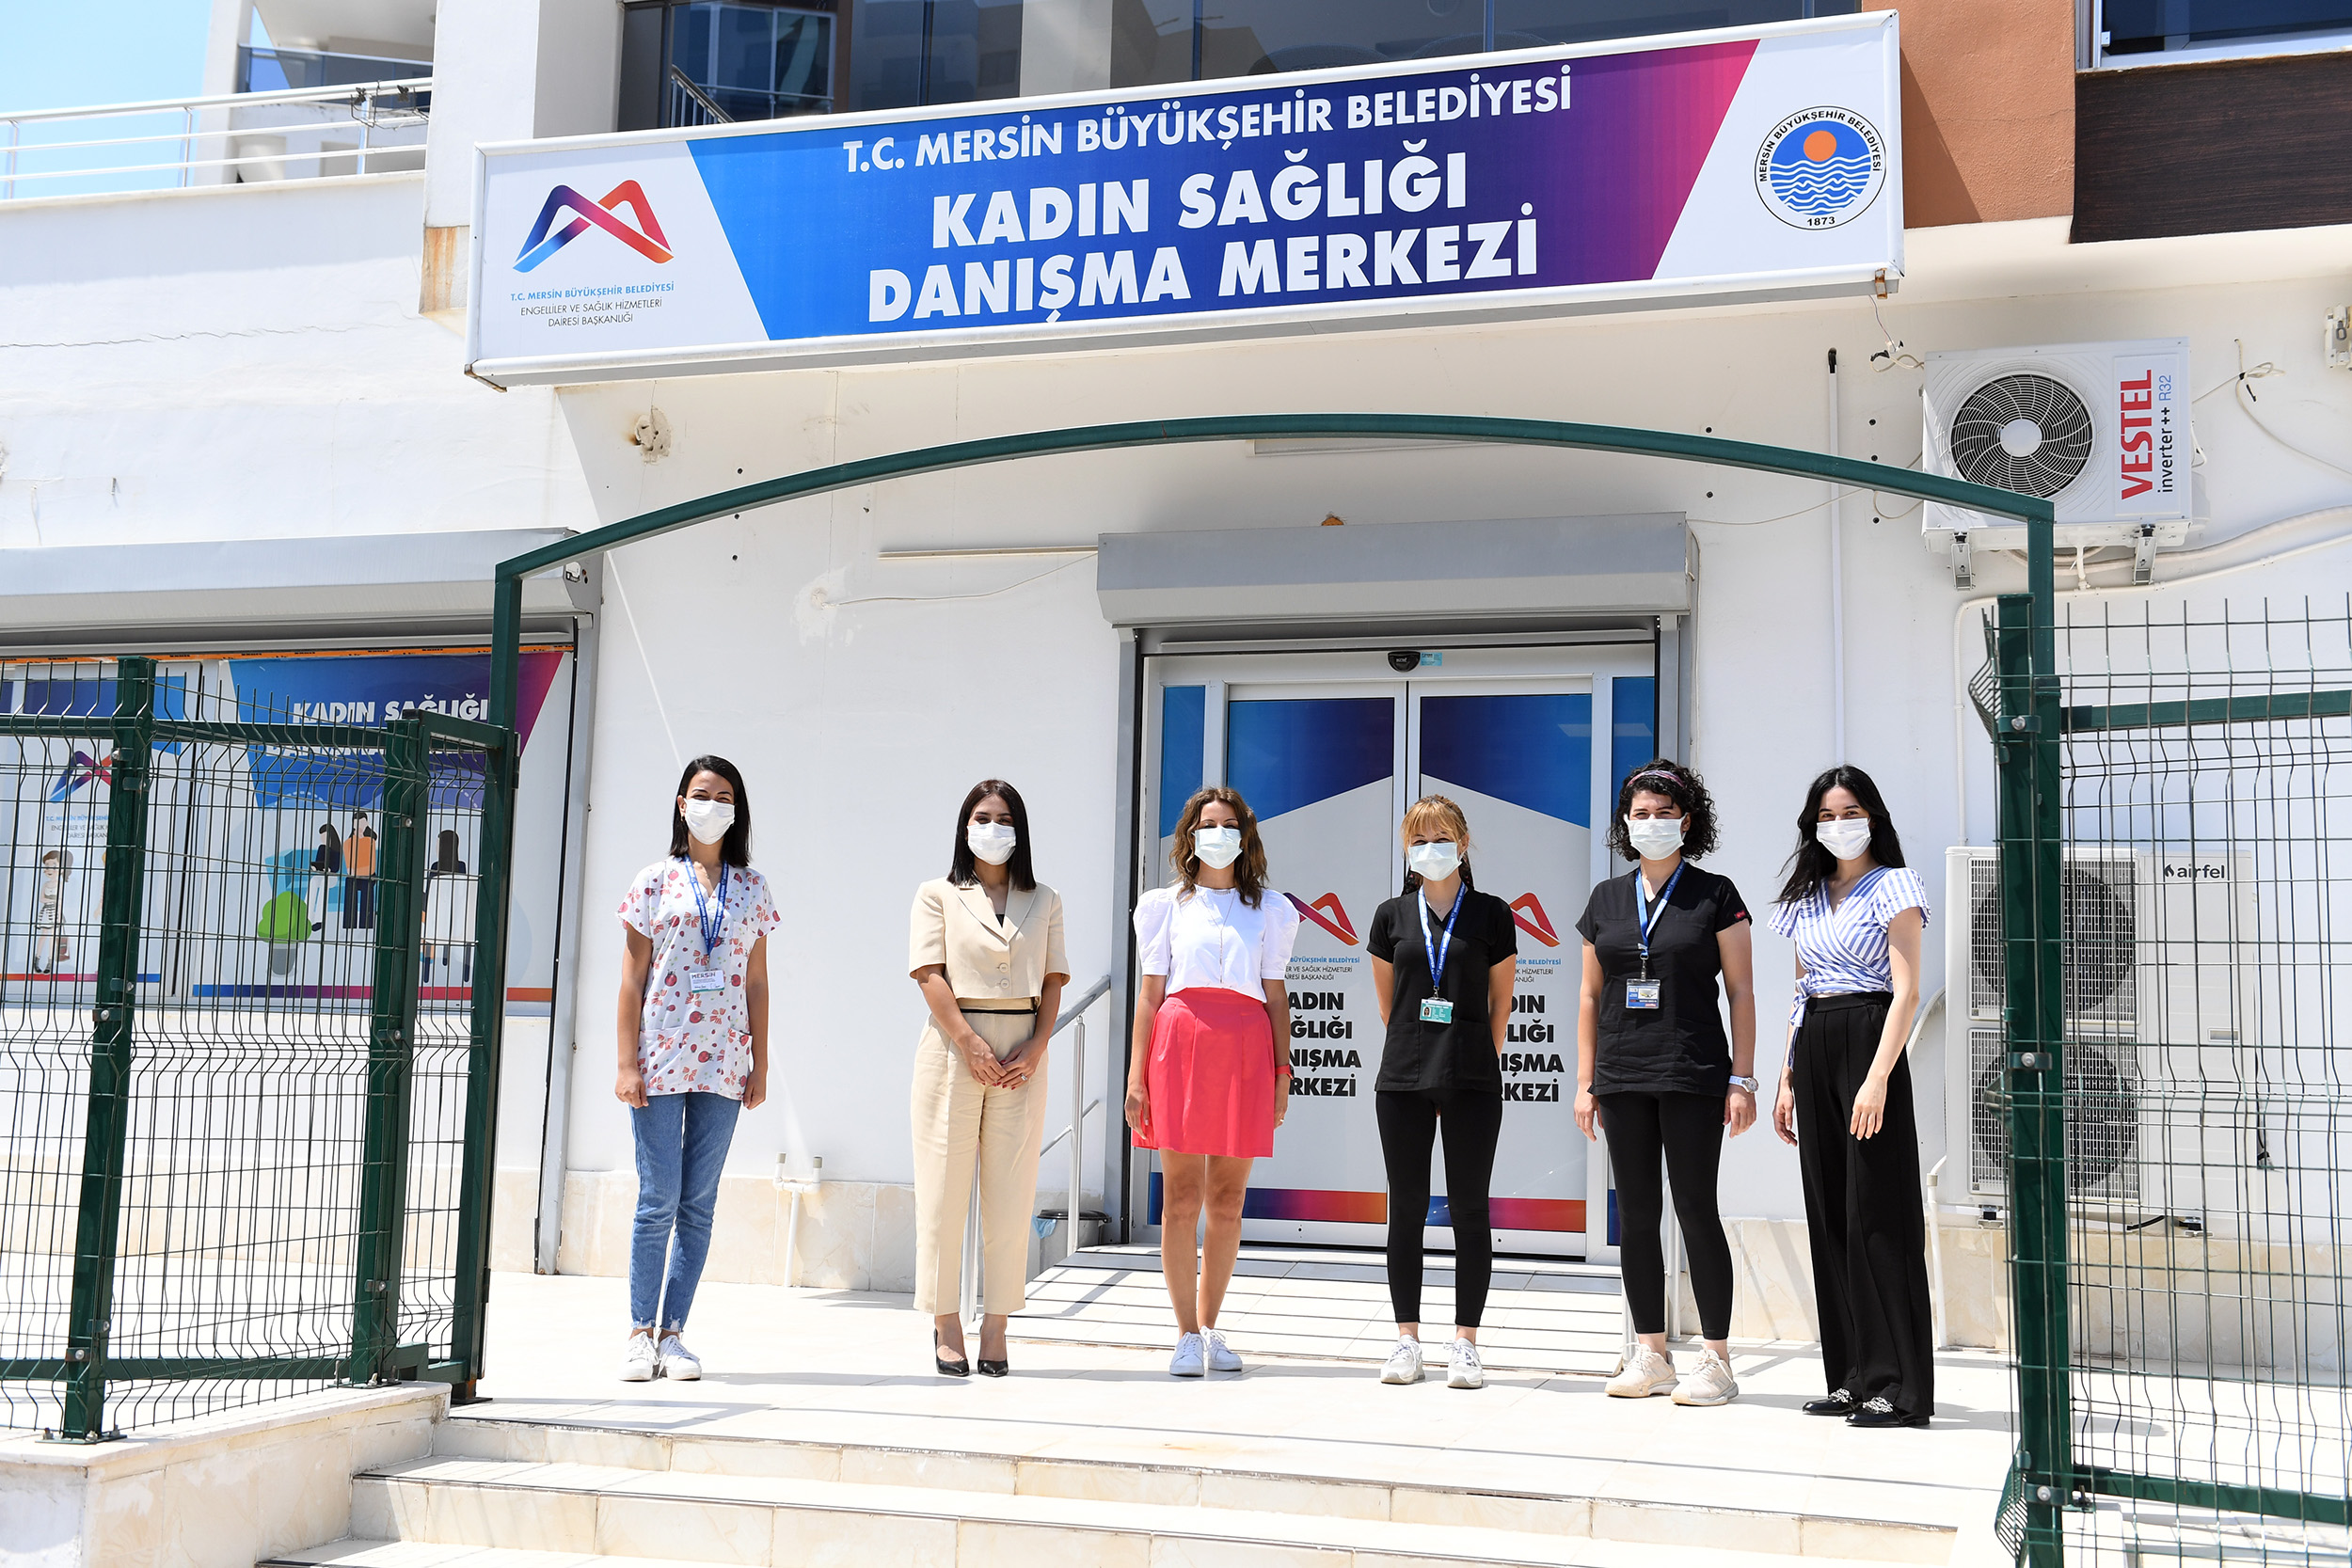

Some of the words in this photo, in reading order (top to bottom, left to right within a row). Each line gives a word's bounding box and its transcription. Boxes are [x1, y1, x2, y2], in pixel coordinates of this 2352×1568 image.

[843, 138, 905, 172] T.C.
[915, 115, 1062, 166] MERSİN
[1077, 88, 1333, 152] BÜYÜKŞEHİR
[1347, 64, 1571, 129] BELEDİYESİ
[1759, 140, 1775, 182] MERSİN
[1773, 110, 1846, 140] BÜYÜKŞEHİR
[1847, 116, 1883, 171] BELEDİYESİ
[932, 179, 1149, 248] KADIN
[1178, 138, 1466, 229] SAĞLIĞI
[1807, 216, 1836, 227] 1873
[868, 246, 1191, 323] DANIŞMA
[1218, 201, 1537, 296] MERKEZİ
[528, 288, 563, 300] MERSİN
[564, 284, 623, 299] BÜYÜKŞEHİR
[626, 280, 675, 293] BELEDİYESİ
[520, 303, 567, 316] ENGELLİLER
[569, 303, 580, 313] VE
[582, 300, 613, 312] SAĞLIK
[615, 296, 662, 310] HİZMETLERİ
[548, 314, 580, 327] DAİRESİ
[581, 311, 633, 325] BAŞKANLIĞI
[2158, 374, 2171, 401] R32
[2121, 369, 2153, 500] VESTEL
[293, 701, 375, 723] KADIN
[2177, 863, 2225, 879] airfel
[1288, 991, 1344, 1010] ADIN
[1290, 1015, 1353, 1039] ĞLIĞI
[1507, 1019, 1554, 1043] LIĞI
[1289, 1049, 1362, 1072] NIŞMA
[1501, 1053, 1565, 1077] IŞMA
[1289, 1073, 1356, 1097] RKEZİ
[1503, 1078, 1559, 1102] KEZİ
